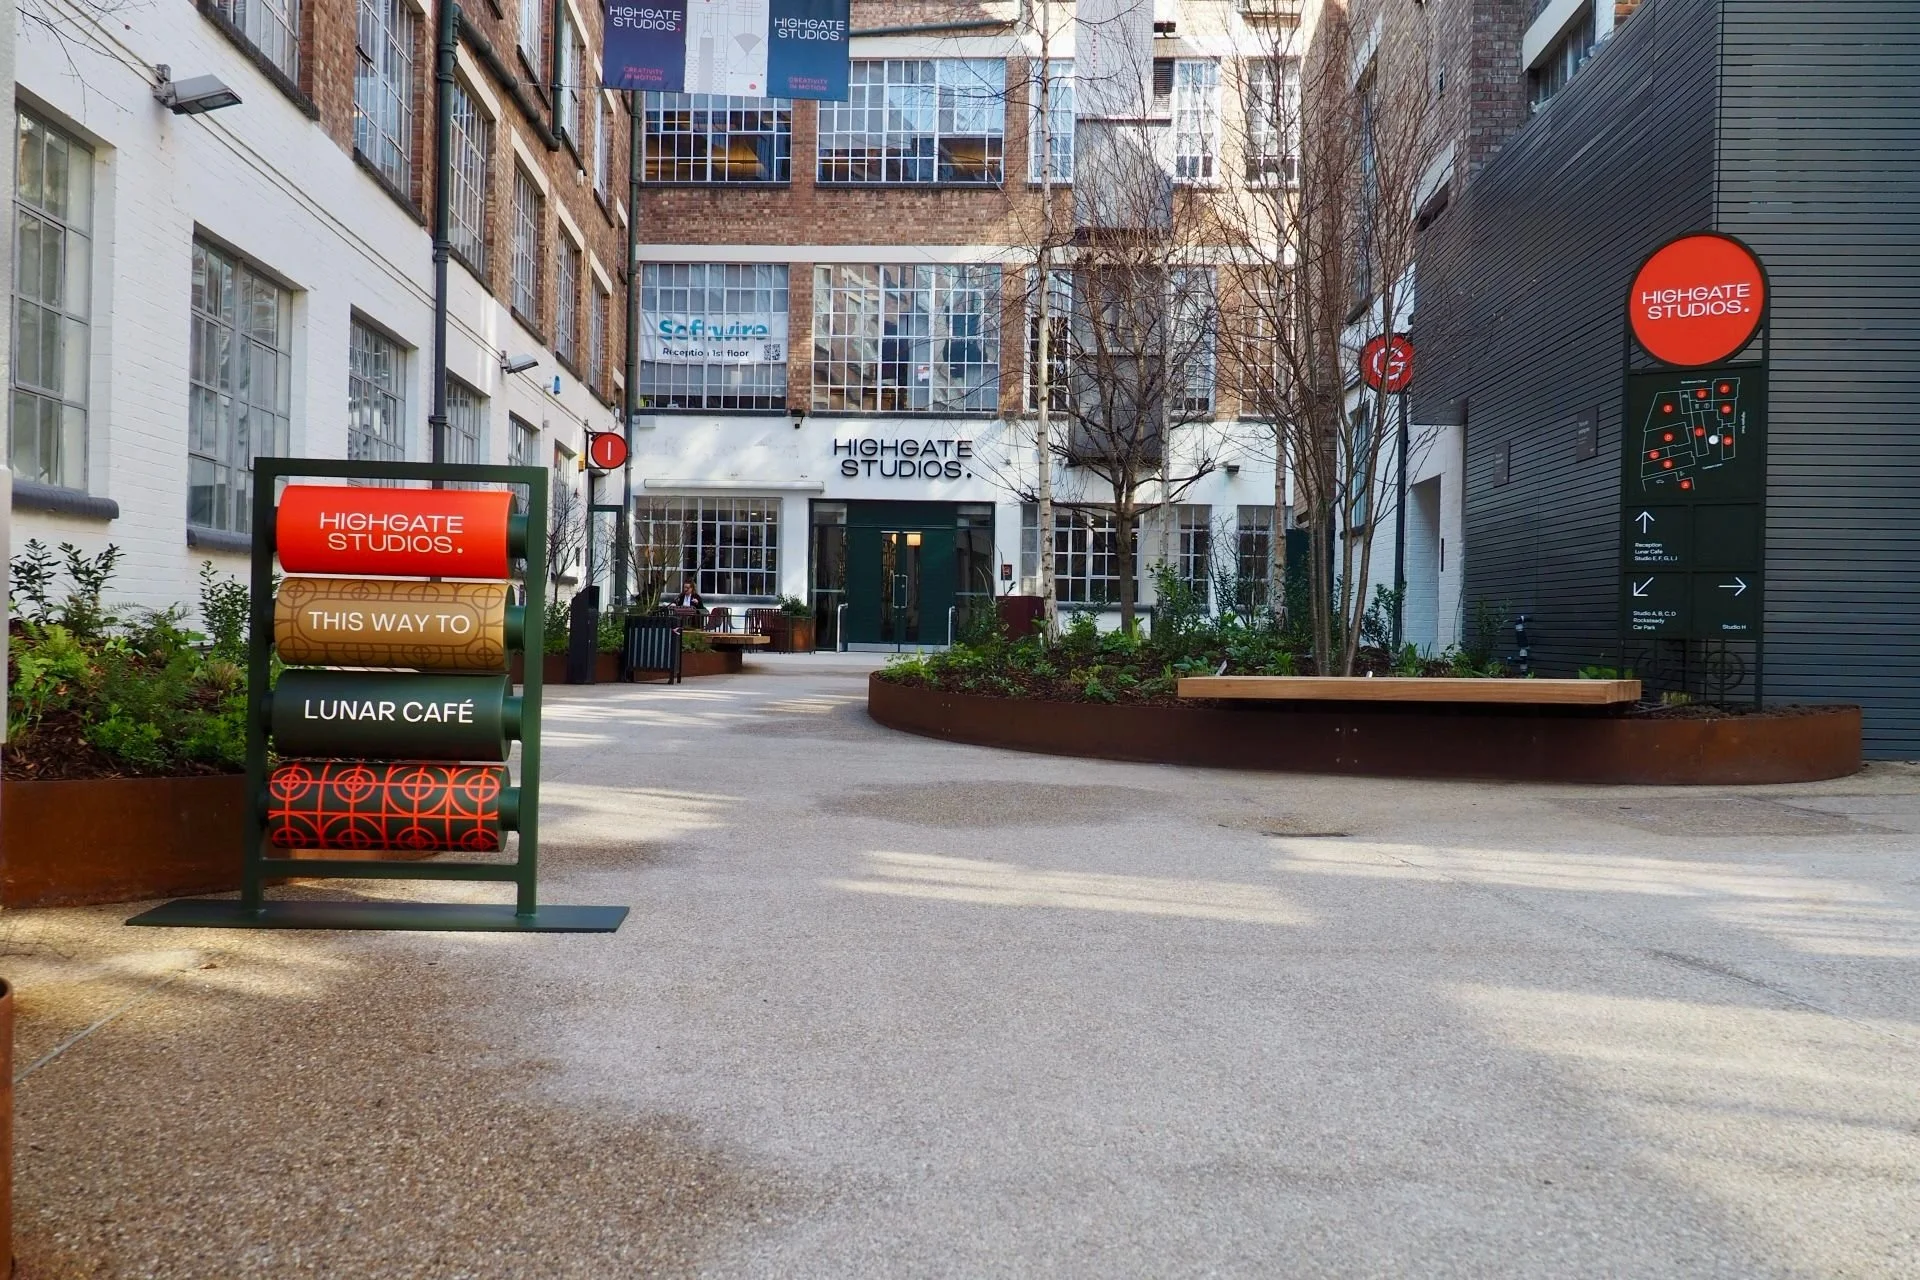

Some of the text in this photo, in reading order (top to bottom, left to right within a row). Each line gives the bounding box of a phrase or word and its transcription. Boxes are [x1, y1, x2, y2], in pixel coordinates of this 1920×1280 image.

[609, 6, 681, 21] HIGHGATE
[613, 17, 681, 32] STUDIOS.
[774, 17, 845, 31] HIGHGATE
[778, 27, 845, 41] STUDIOS.
[623, 66, 664, 76] CREATIVITY
[634, 74, 663, 82] MOTION
[788, 76, 828, 86] CREATIVITY
[798, 84, 827, 92] MOTION
[1641, 283, 1751, 305] HIGHGATE
[1646, 300, 1751, 321] STUDIOS.
[727, 349, 750, 357] floor
[1372, 347, 1407, 380] G
[834, 438, 973, 458] HIGHGATE
[841, 459, 972, 479] STUDIOS.
[319, 512, 464, 533] HIGHGATE
[328, 532, 464, 555] STUDIOS.
[308, 611, 471, 634] THIS WAY TO
[304, 698, 474, 724] LUNAR CAFÉ
